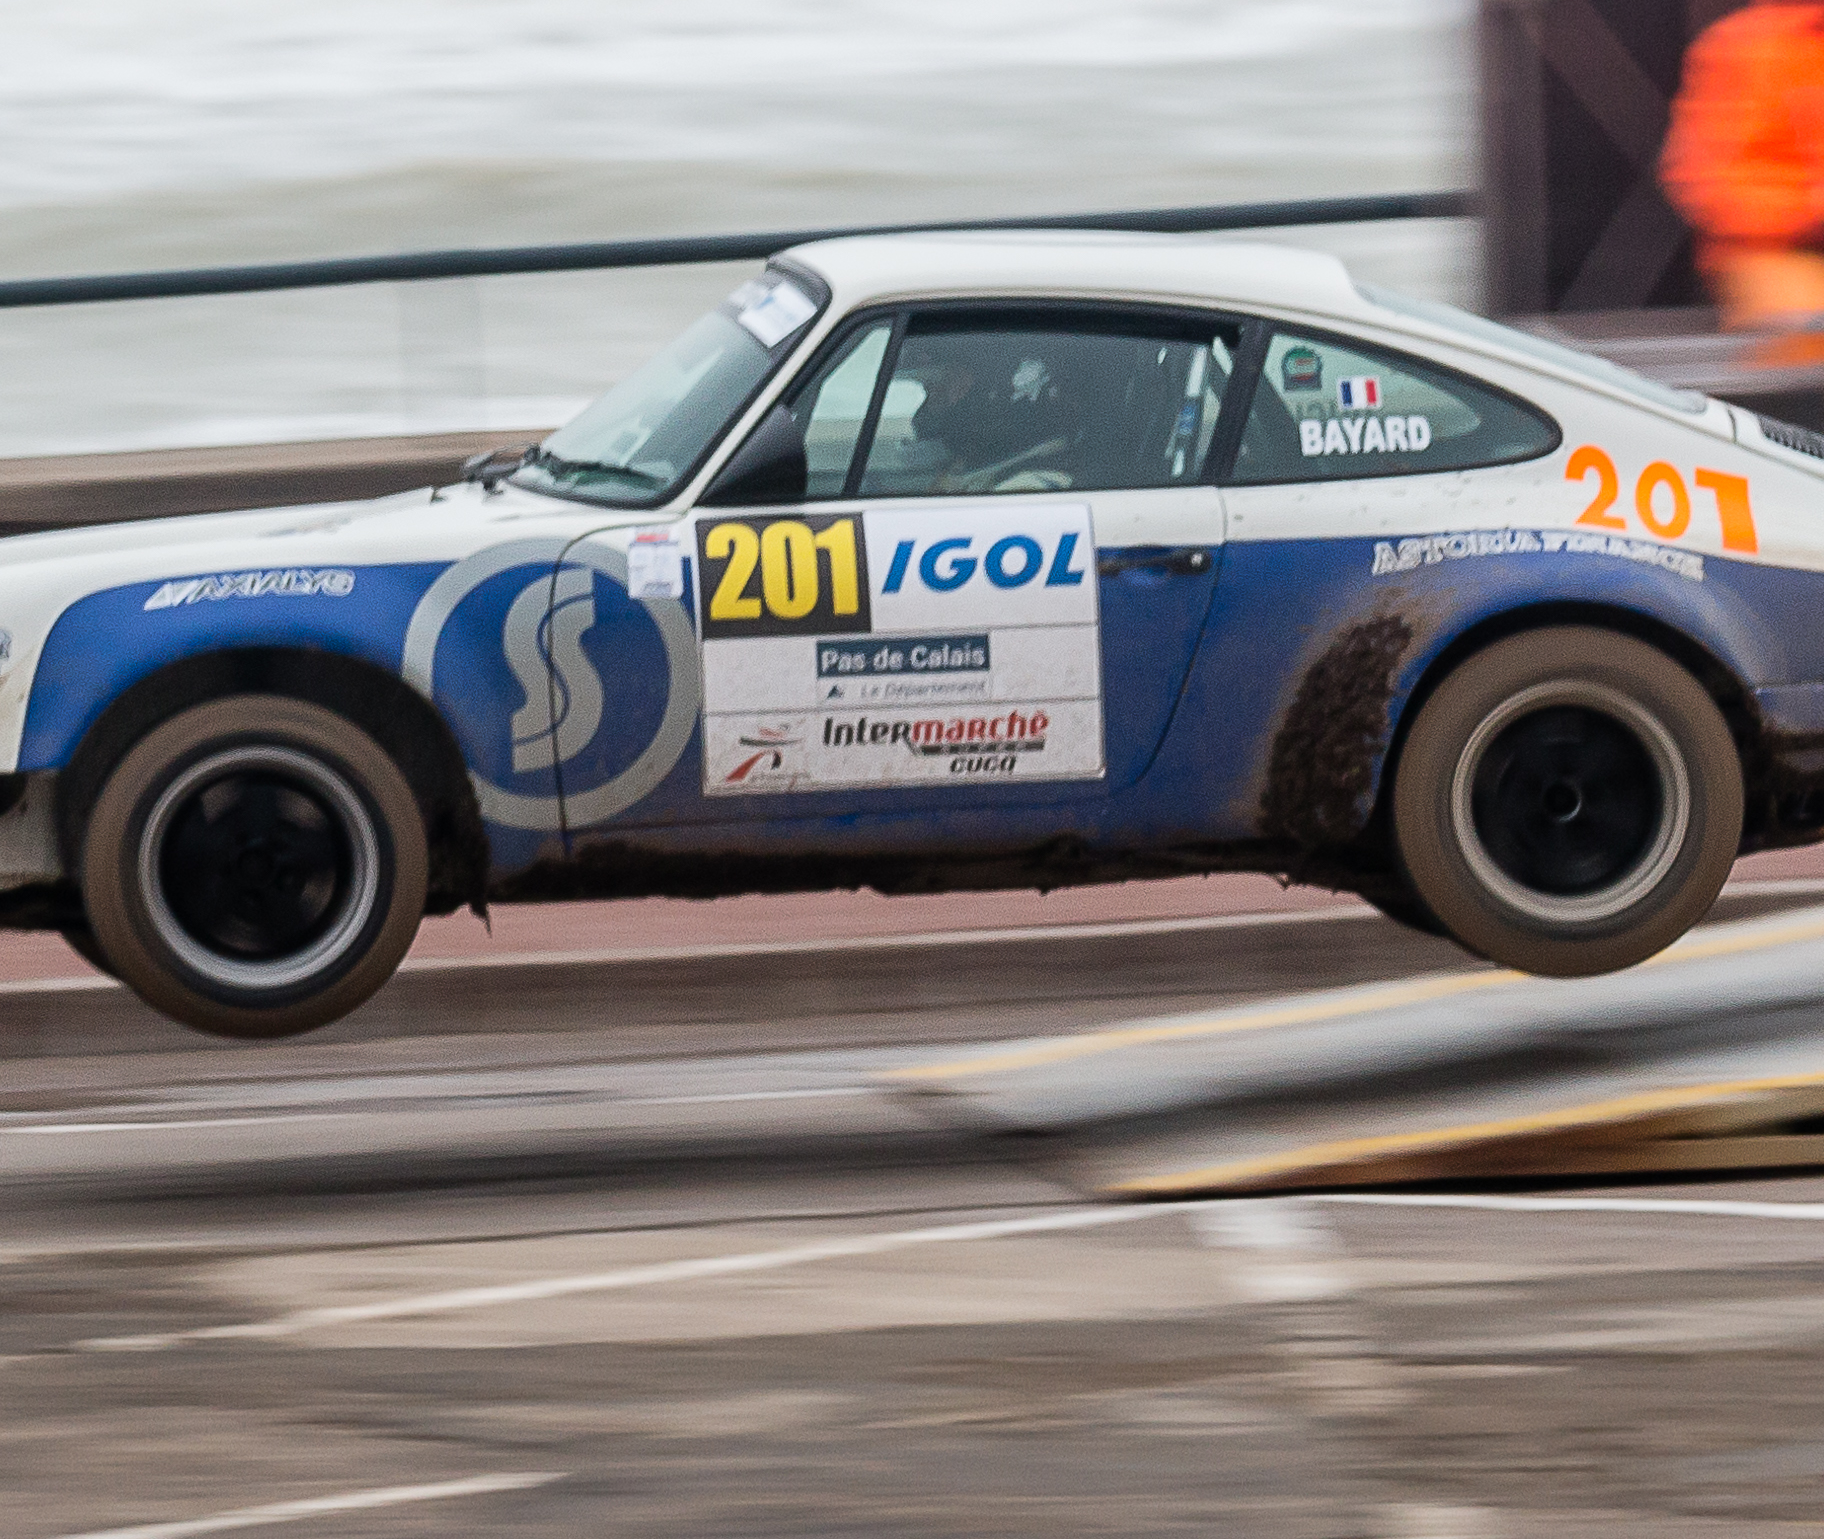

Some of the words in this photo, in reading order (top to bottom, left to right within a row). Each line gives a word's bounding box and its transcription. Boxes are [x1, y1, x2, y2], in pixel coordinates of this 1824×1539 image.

[1300, 416, 1432, 456] BAYARD
[1565, 445, 1758, 555] 201
[706, 519, 858, 621] 201
[881, 532, 1085, 595] IGOL
[821, 647, 866, 673] Pas
[873, 644, 904, 671] de
[910, 642, 986, 670] Calais
